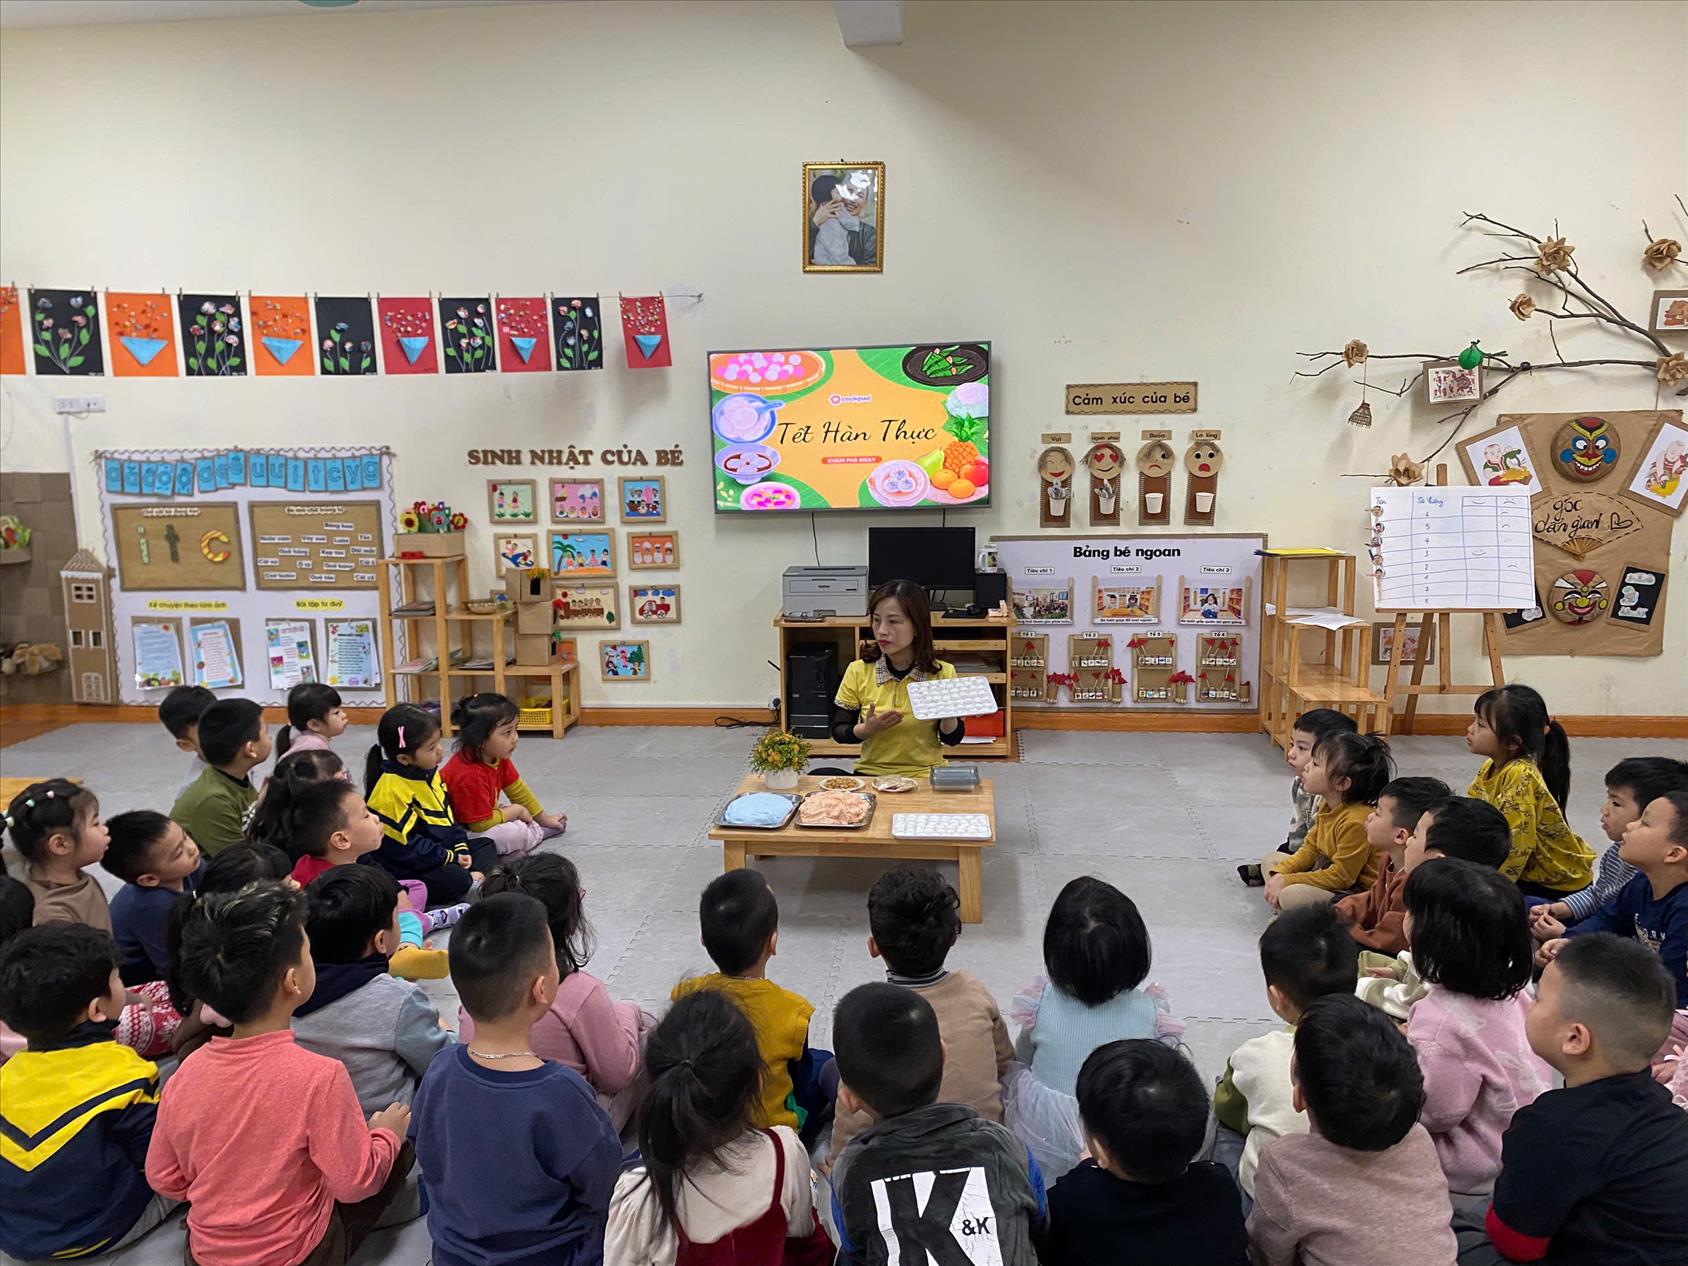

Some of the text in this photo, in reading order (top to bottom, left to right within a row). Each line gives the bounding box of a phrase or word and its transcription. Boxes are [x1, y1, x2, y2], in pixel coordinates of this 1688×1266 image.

[1072, 392, 1190, 406] Cảm xúc của bé
[778, 419, 938, 445] Tết Hàn Thực
[467, 444, 684, 470] SINH NHẬT CỦA BÉ
[1553, 496, 1582, 522] góc
[1568, 513, 1603, 538] gian
[165, 524, 180, 562] t
[200, 530, 232, 563] c
[1073, 545, 1181, 560] Bảng bé ngoan
[962, 1217, 992, 1236] &K
